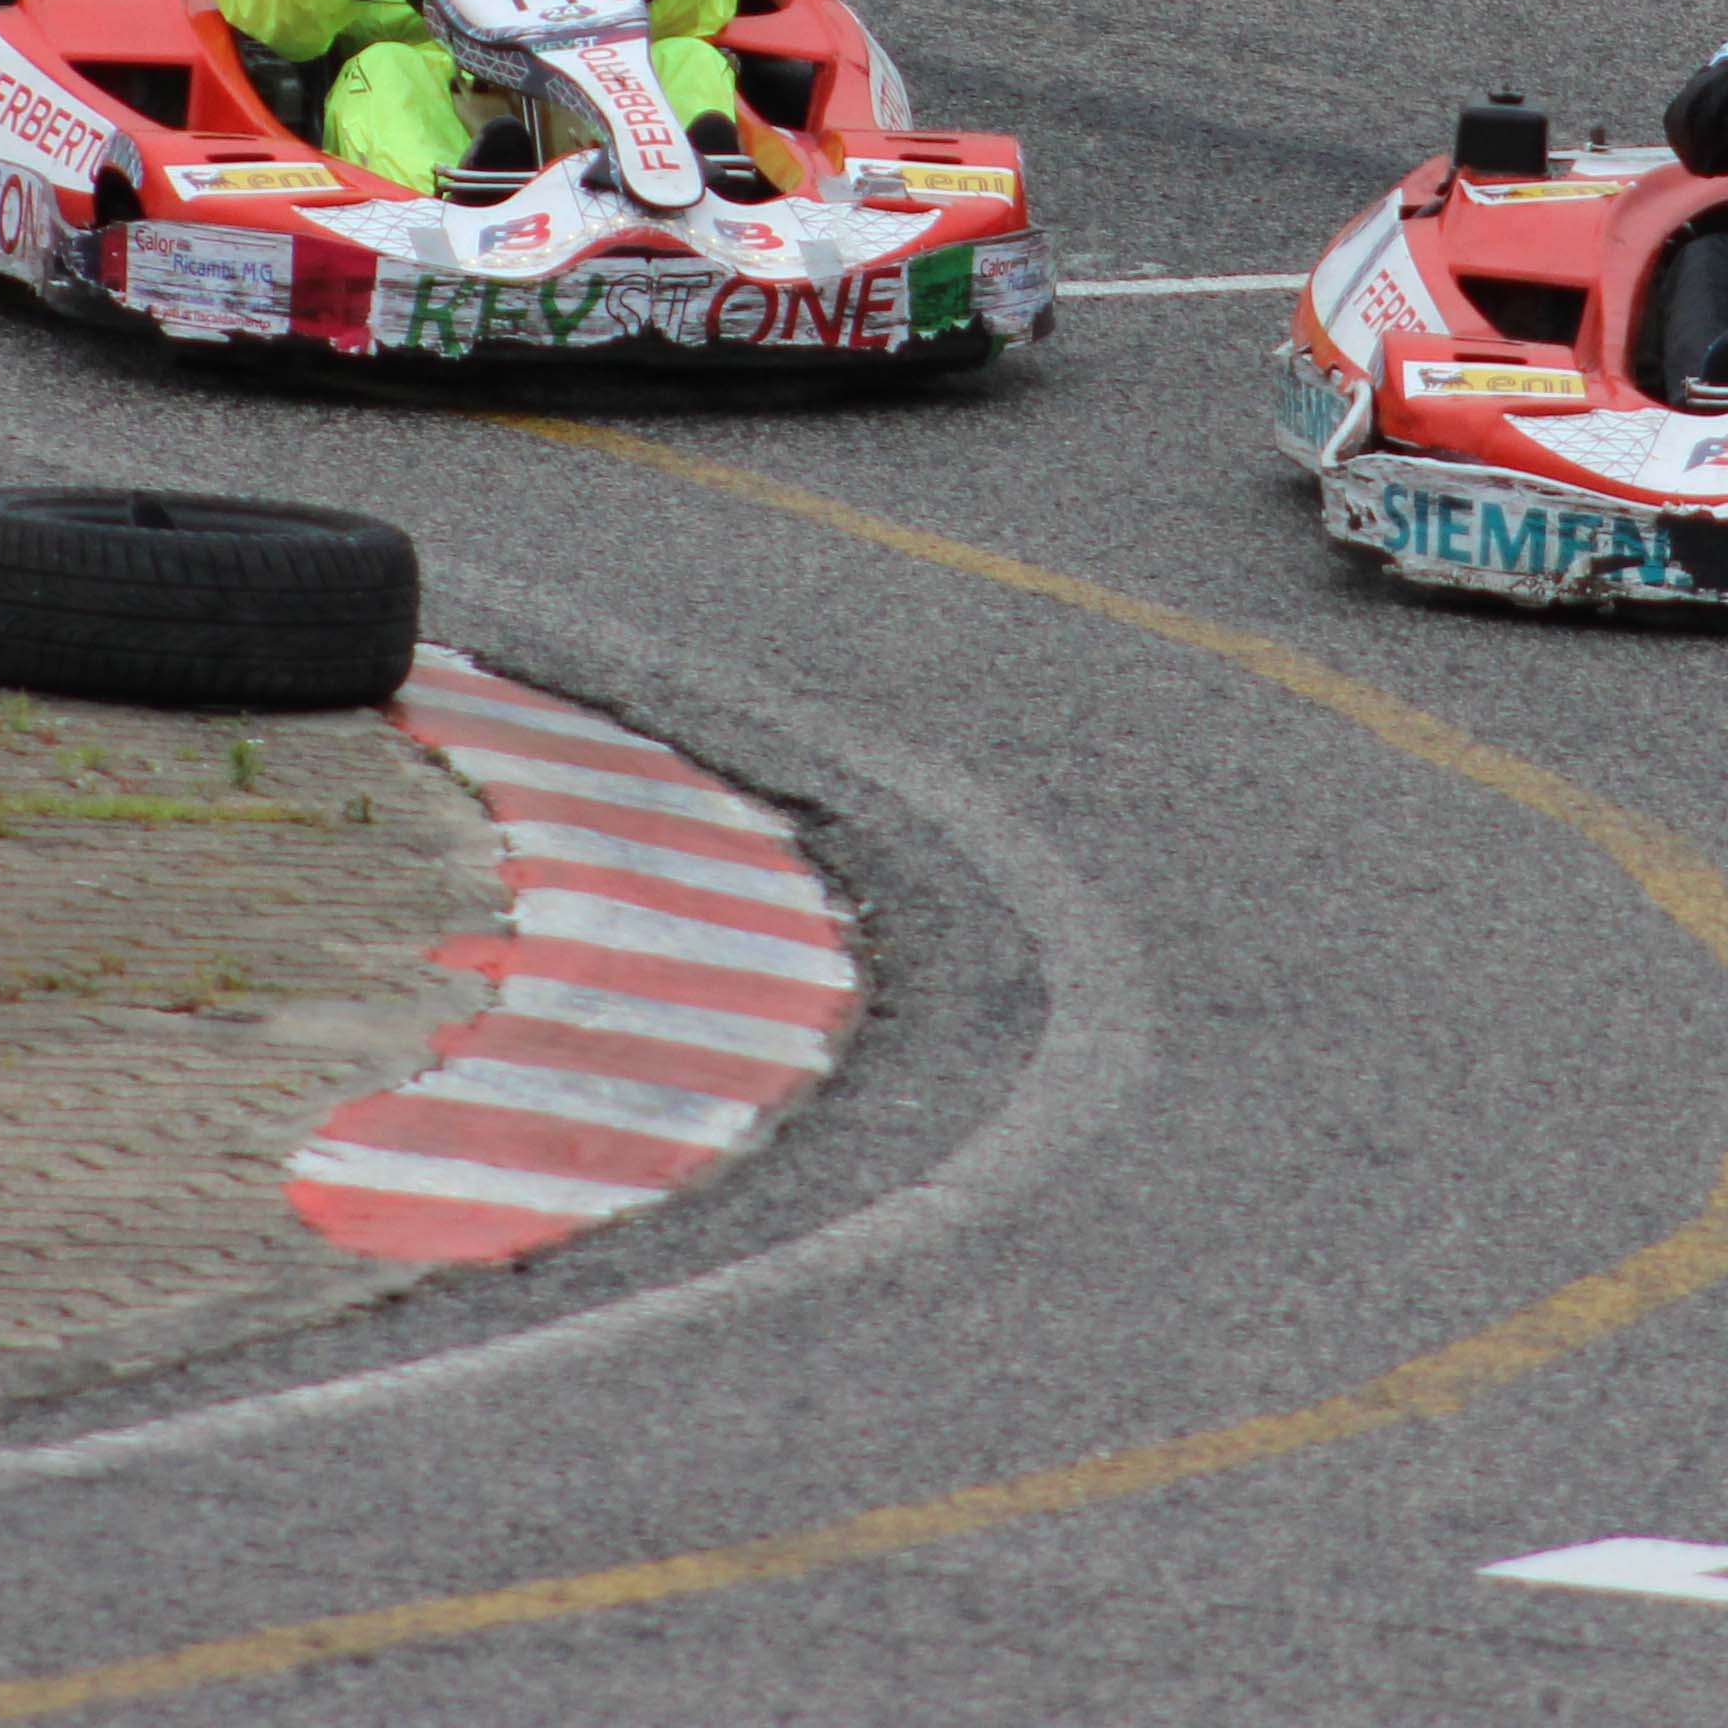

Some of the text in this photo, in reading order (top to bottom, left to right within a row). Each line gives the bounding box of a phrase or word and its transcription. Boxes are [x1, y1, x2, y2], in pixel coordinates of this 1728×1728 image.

[577, 47, 681, 171] FERBERTO
[406, 266, 903, 358] KEYSTONE
[1383, 482, 1694, 588] SIEMEN
